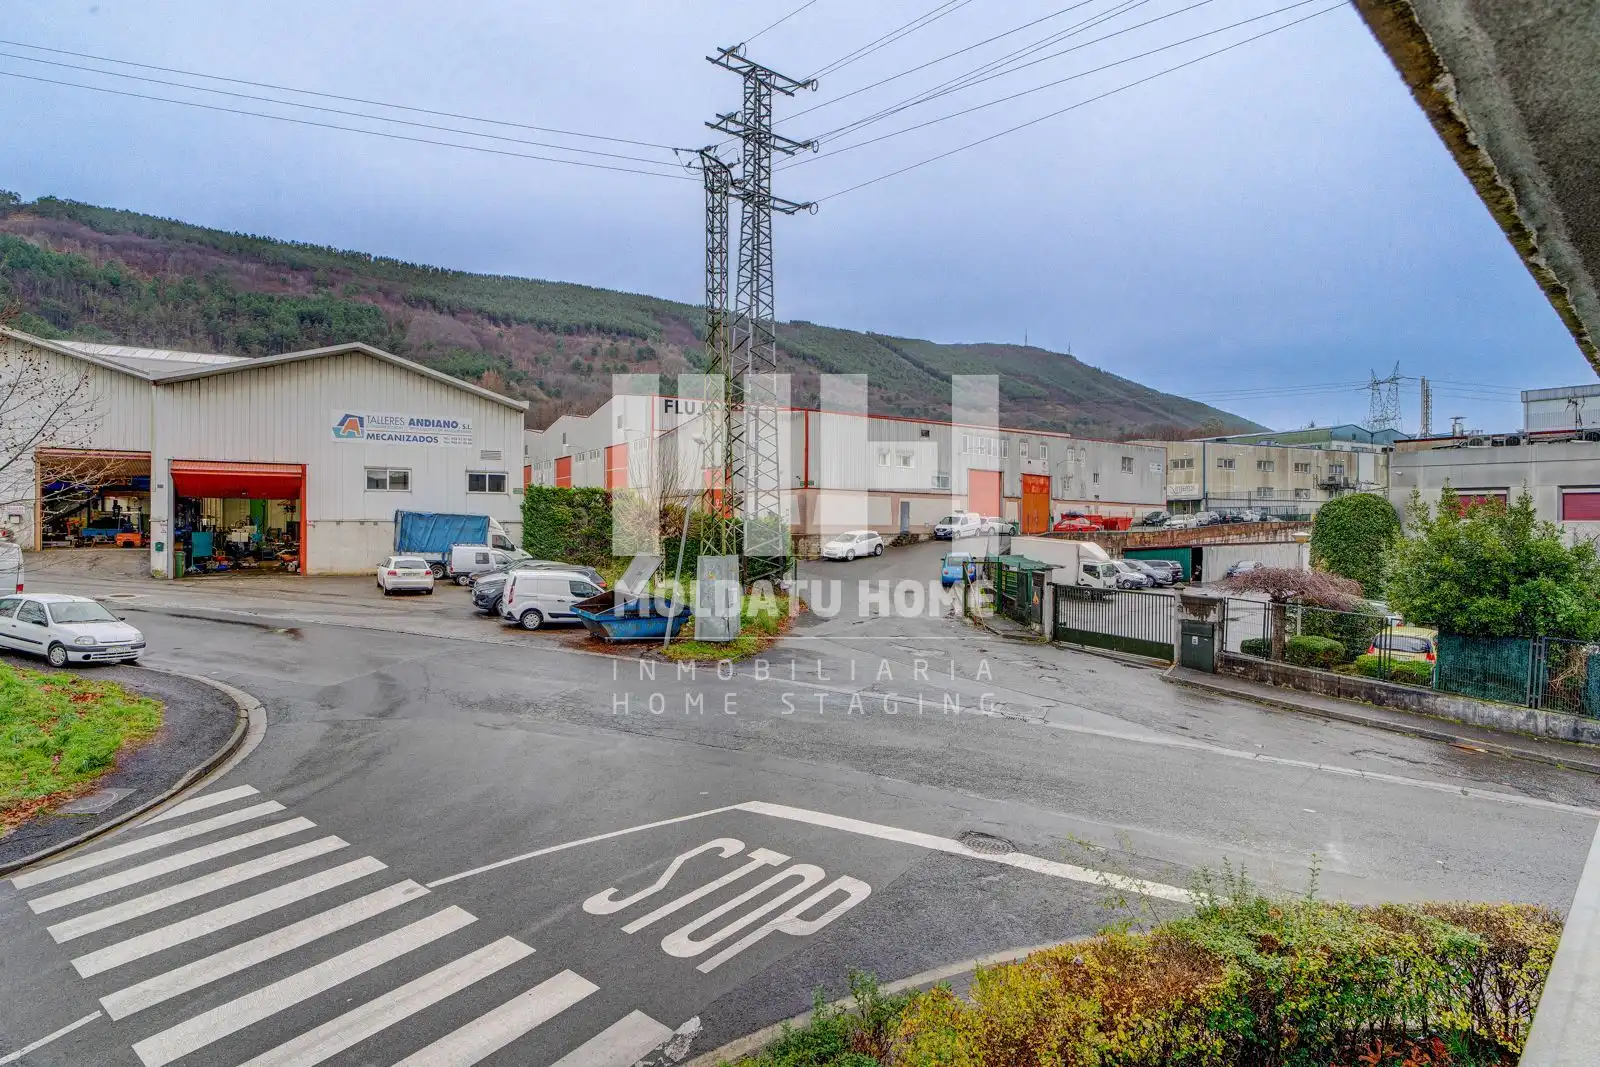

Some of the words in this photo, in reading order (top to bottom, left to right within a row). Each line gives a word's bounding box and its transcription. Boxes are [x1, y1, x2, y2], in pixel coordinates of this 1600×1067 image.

[366, 415, 405, 426] TALLERES
[366, 432, 439, 444] MECANIZADOS
[582, 838, 872, 973] STOP
